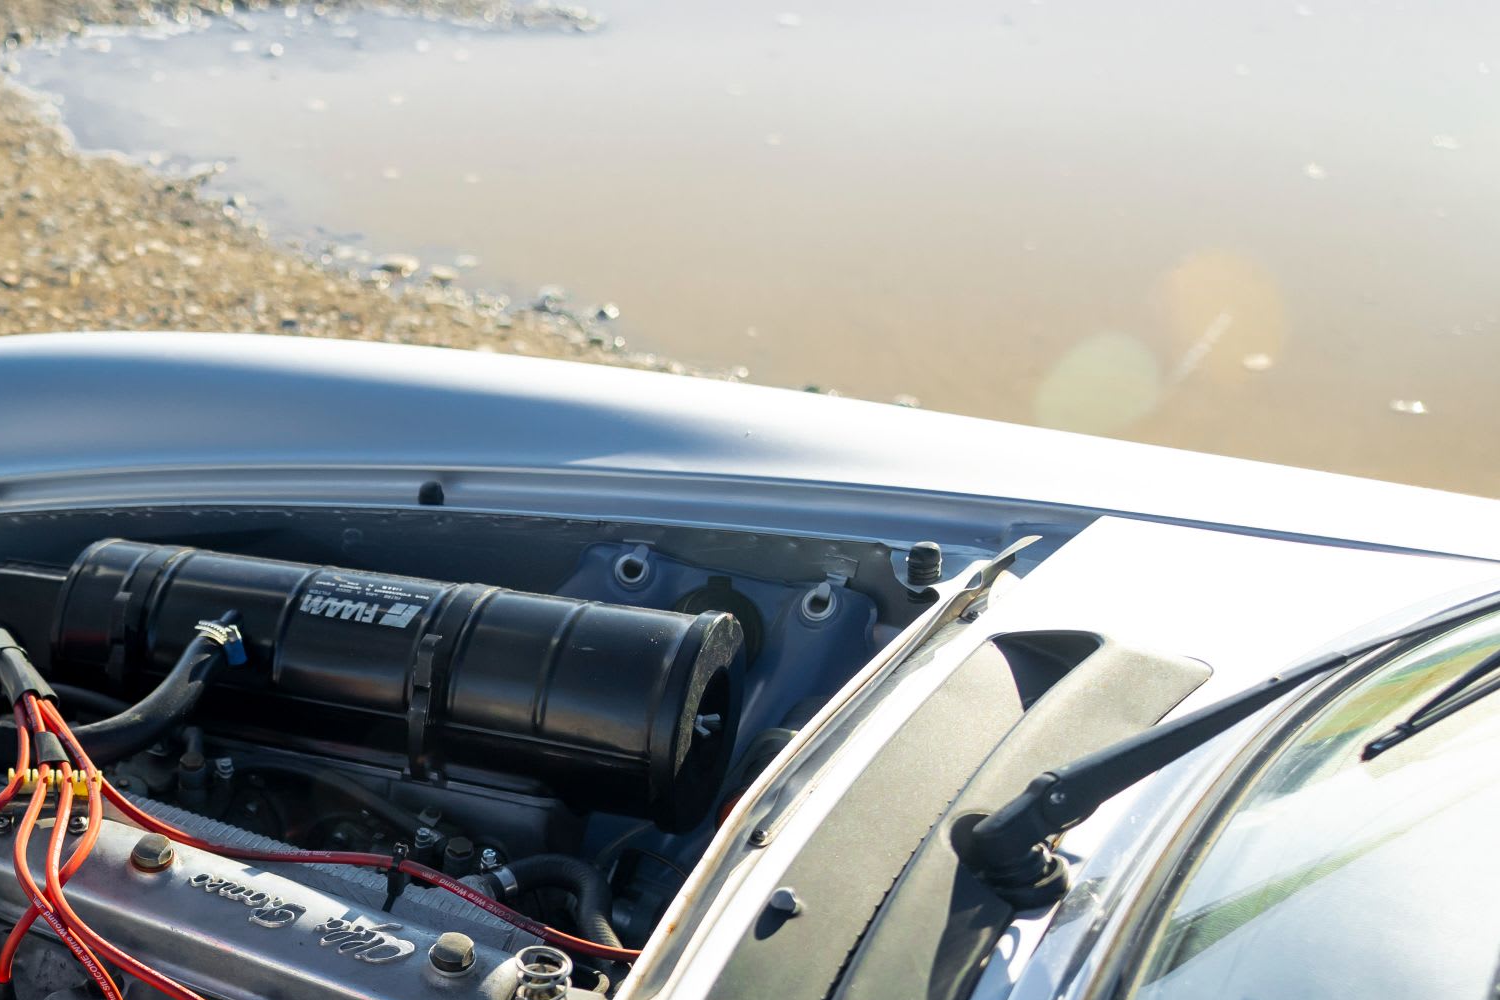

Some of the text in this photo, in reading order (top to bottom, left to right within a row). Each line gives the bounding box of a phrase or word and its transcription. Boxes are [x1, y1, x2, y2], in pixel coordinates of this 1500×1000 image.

[300, 593, 380, 624] FIAAM
[439, 878, 467, 897] Wound
[467, 892, 486, 906] Wire
[43, 910, 68, 939] Wound
[188, 873, 415, 963] Alfa Romeo
[67, 936, 83, 956] Wire
[81, 954, 111, 991] SILICONE
